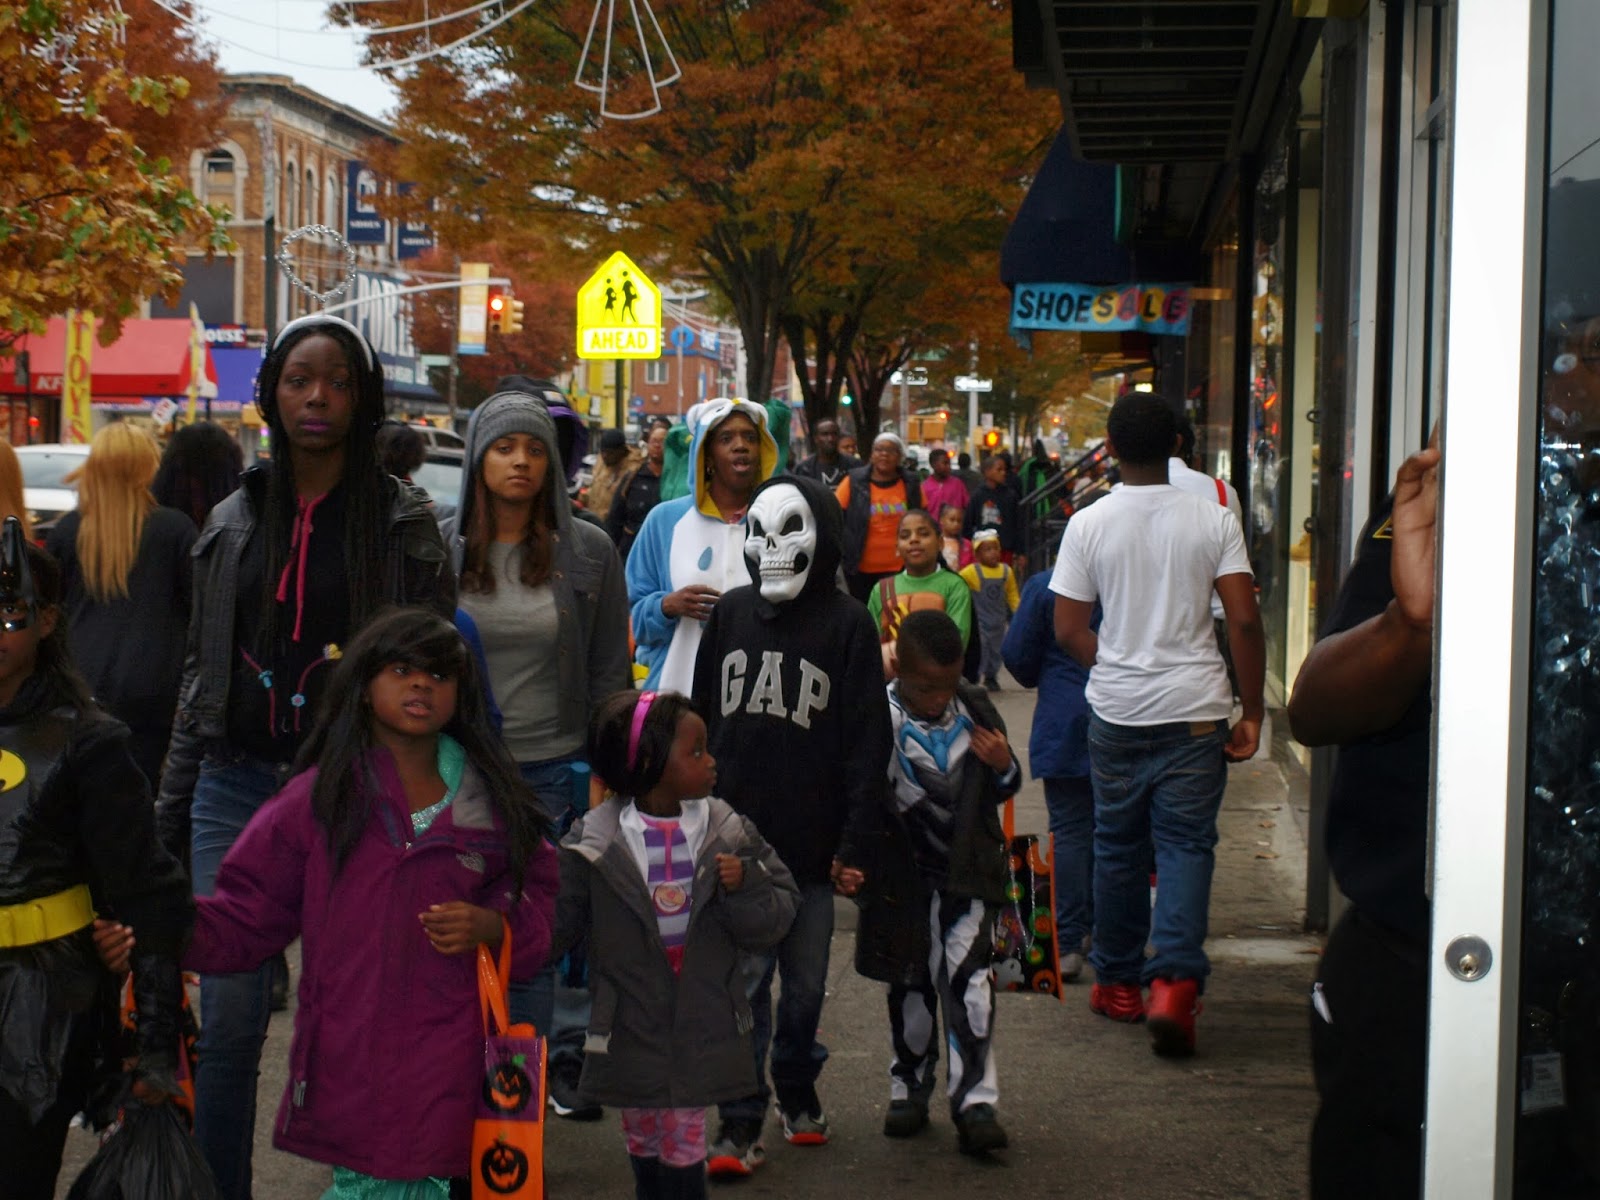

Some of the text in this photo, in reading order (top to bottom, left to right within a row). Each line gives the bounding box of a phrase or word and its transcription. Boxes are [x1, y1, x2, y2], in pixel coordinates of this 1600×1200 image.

[203, 328, 245, 342] OUSE
[590, 331, 648, 349] AHEAD
[36, 375, 64, 391] KF
[720, 648, 831, 730] GAP
